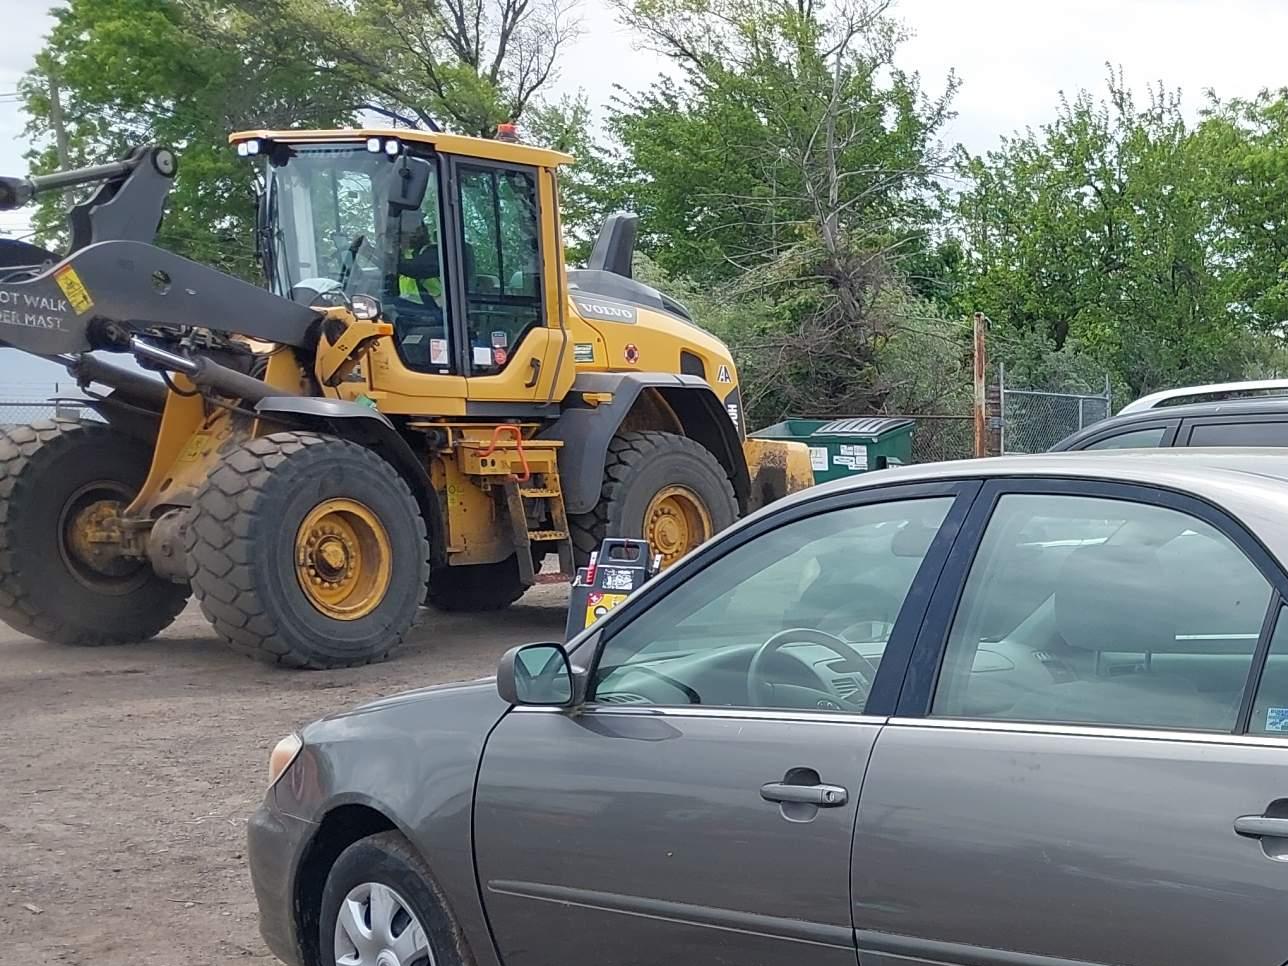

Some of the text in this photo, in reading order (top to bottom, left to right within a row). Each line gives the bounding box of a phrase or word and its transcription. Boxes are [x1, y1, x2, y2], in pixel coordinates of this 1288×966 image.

[24, 295, 67, 312] WALK
[578, 302, 633, 318] VOLVO
[24, 313, 62, 328] MAST
